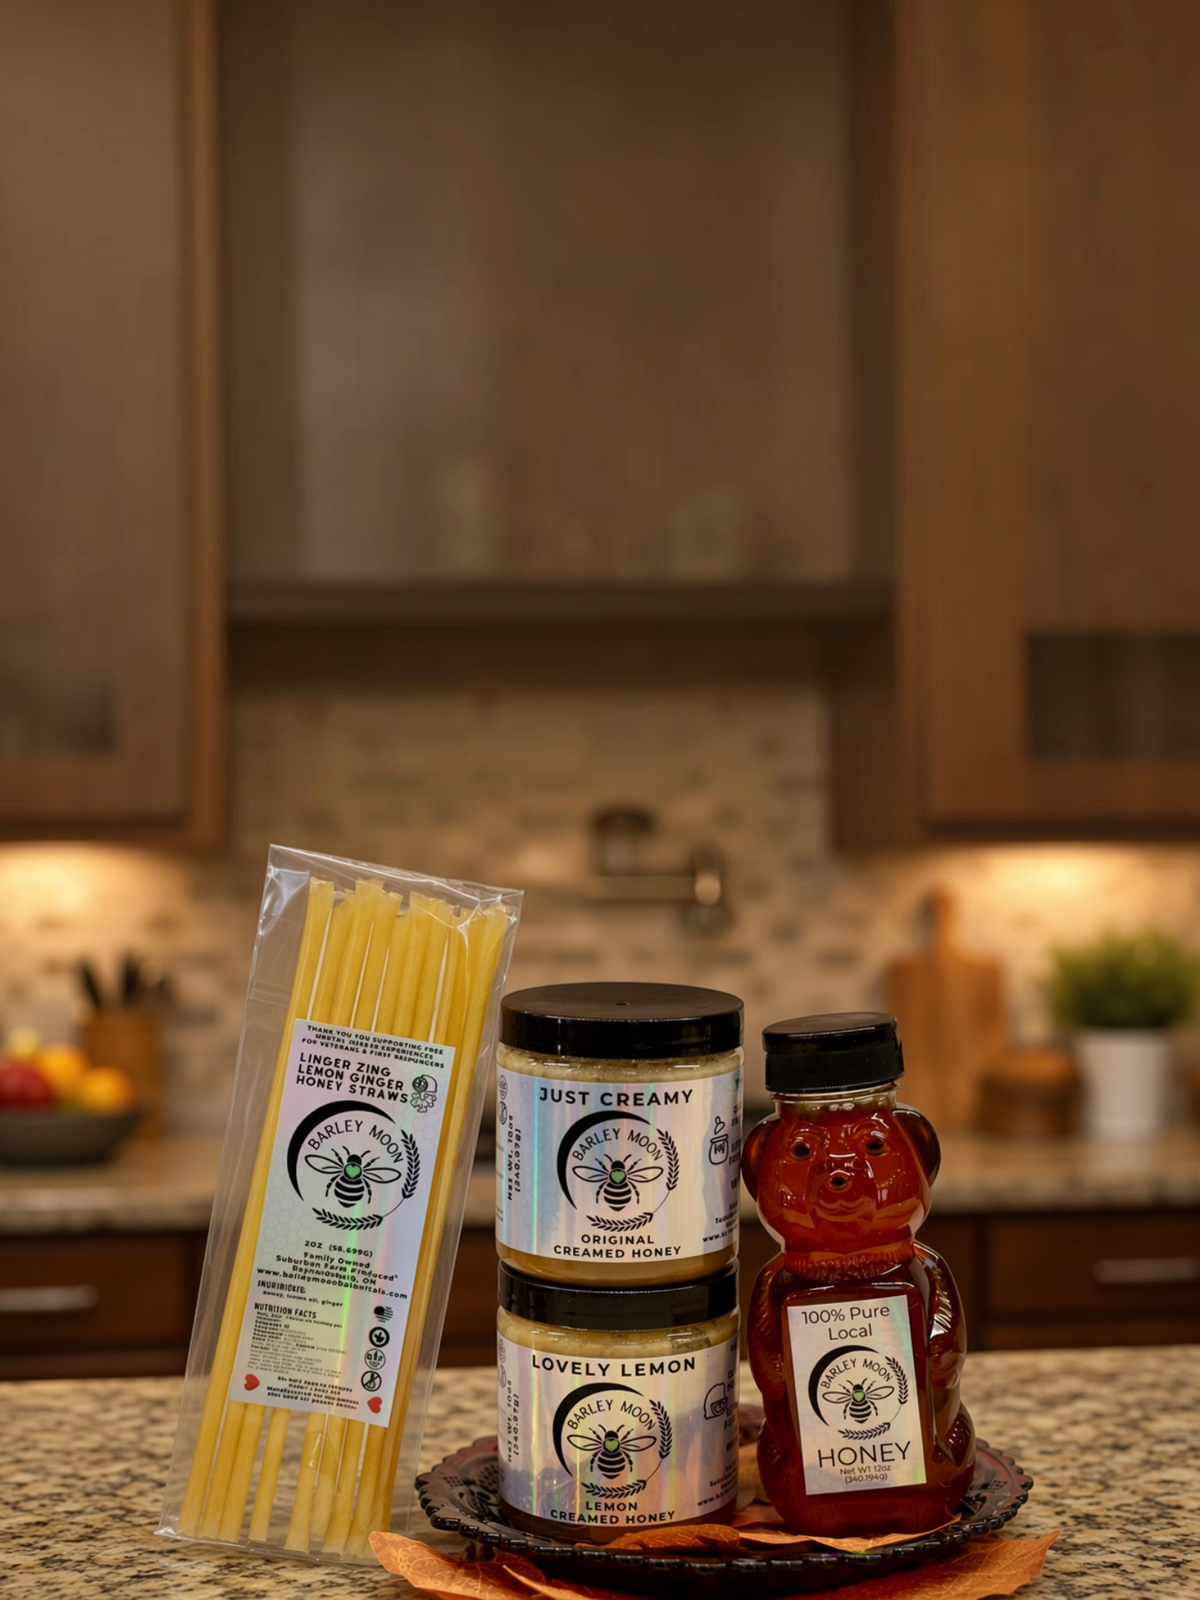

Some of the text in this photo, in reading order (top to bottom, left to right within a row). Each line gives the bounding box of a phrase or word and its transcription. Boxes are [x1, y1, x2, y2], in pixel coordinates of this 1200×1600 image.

[307, 1025, 333, 1035] THANK
[337, 1029, 352, 1038] YOU
[373, 1037, 422, 1051] SUPPORTING
[300, 1052, 391, 1077] LINGER ZING
[298, 1064, 404, 1091] LEMON GINGER
[296, 1075, 409, 1104] HONEY STRAWS
[539, 1087, 693, 1107] JUST CREAMY
[307, 1119, 404, 1164] BARLEY MOON
[572, 1128, 664, 1162] BARLEY MOON
[581, 1234, 654, 1245] ORIGINAL
[303, 1252, 370, 1269] Family Owned
[553, 1245, 682, 1258] CREAMED HONEY
[276, 1255, 321, 1269] Suburban
[362, 1277, 376, 1286] ON
[295, 1309, 317, 1319] FACTS
[801, 1305, 890, 1325] 100% Pure
[828, 1323, 873, 1341] Local
[532, 1354, 696, 1377] LOVELY LEMON
[820, 1358, 893, 1390] BARLEY MOON
[567, 1399, 657, 1431] BARLEY MOON
[817, 1441, 911, 1468] HONEY
[839, 1467, 856, 1476] Net
[873, 1464, 891, 1472] 12oz
[550, 1509, 675, 1524] CREAMED HONEY
[585, 1501, 638, 1512] LEMON
